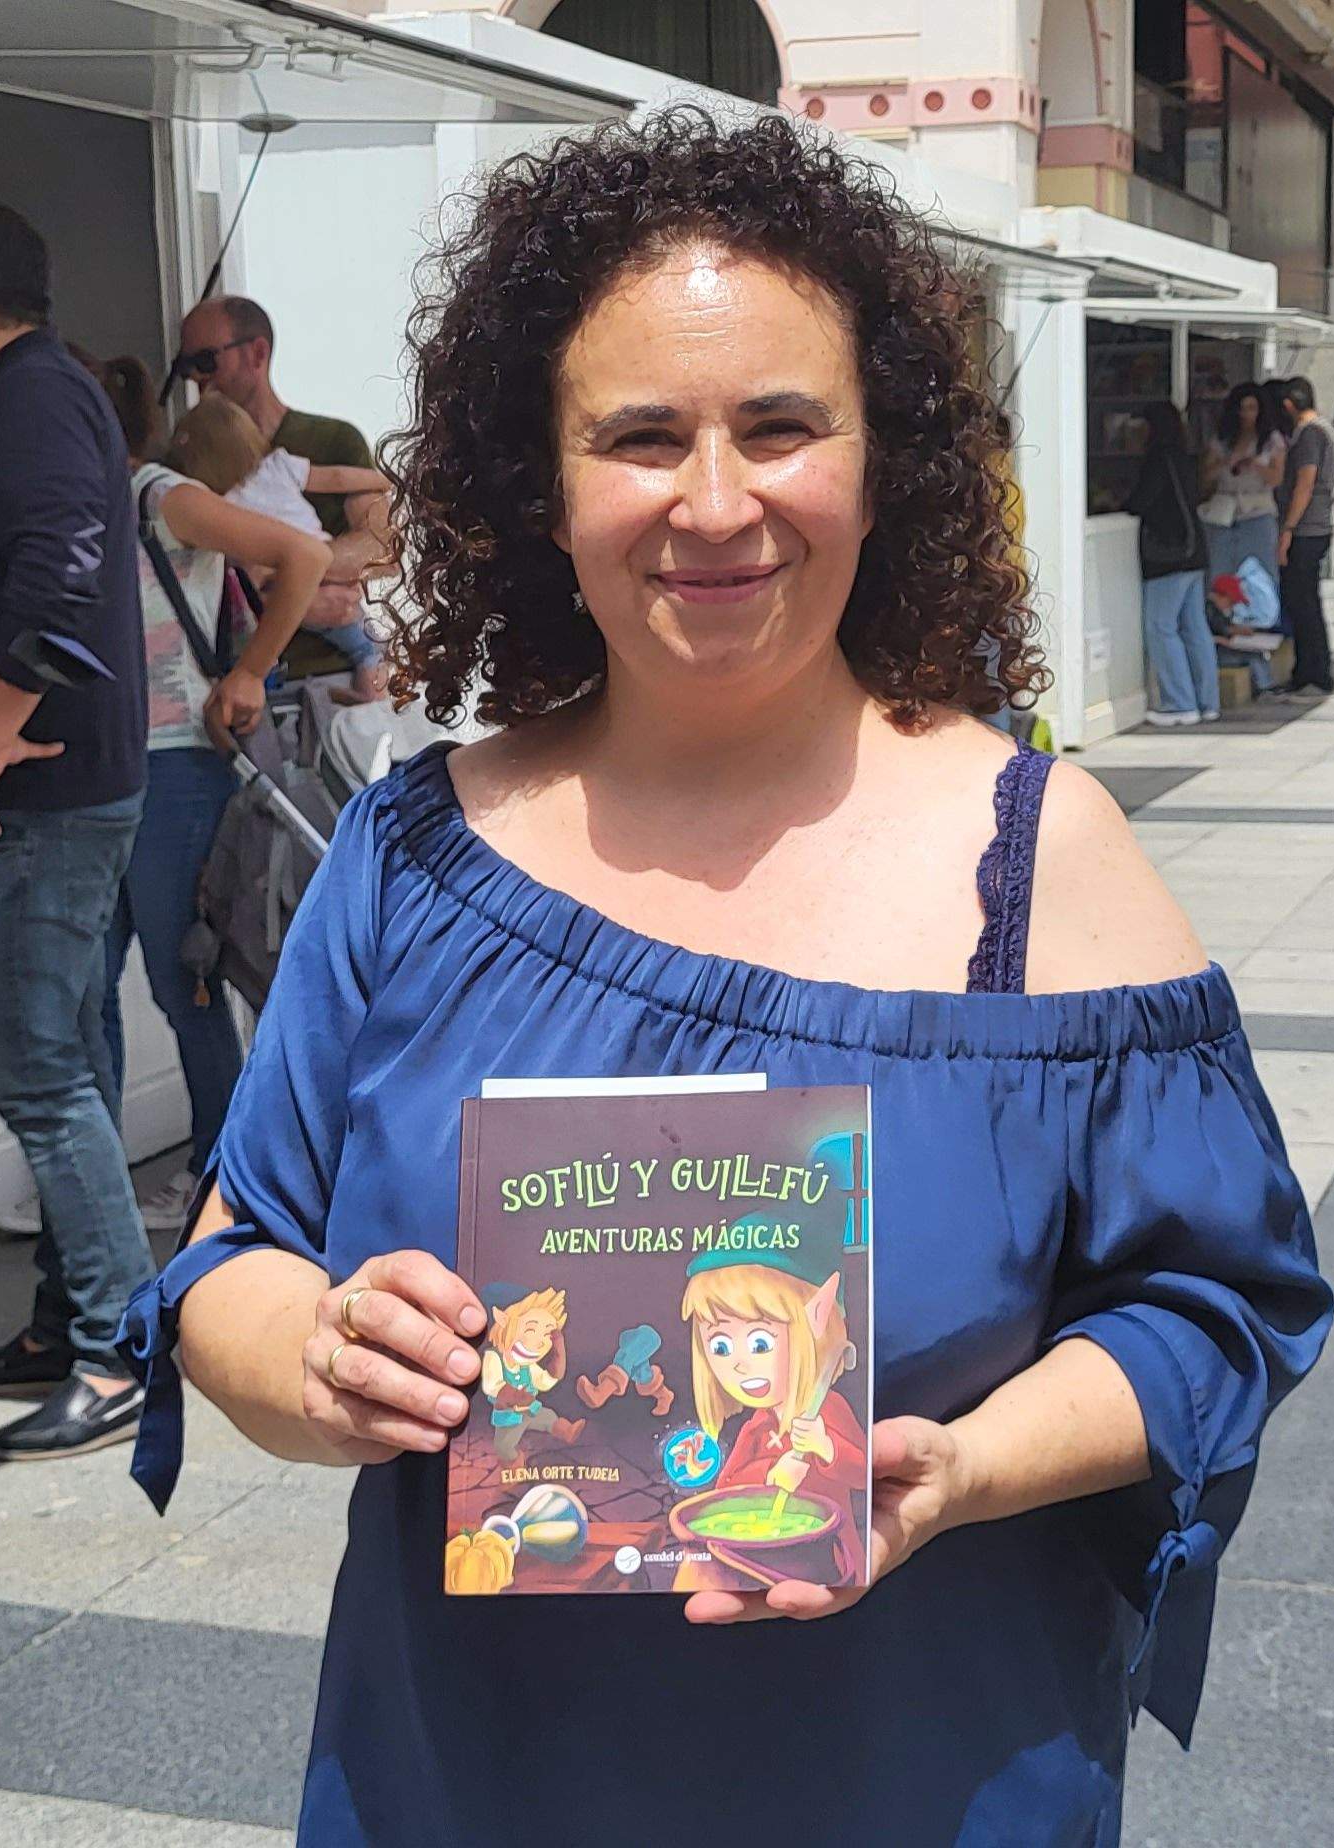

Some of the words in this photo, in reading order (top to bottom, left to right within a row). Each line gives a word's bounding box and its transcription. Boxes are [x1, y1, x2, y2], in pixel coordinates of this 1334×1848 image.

[500, 1152, 620, 1212] SOFILÚ
[629, 1158, 659, 1198] Y
[670, 1154, 830, 1205] GUILLEFÚ
[540, 1227, 684, 1254] AVENTURAS
[691, 1219, 801, 1252] MÁGICAS
[501, 1466, 540, 1484] ELENA
[542, 1465, 575, 1481] ORTE
[576, 1466, 620, 1482] TUDELA
